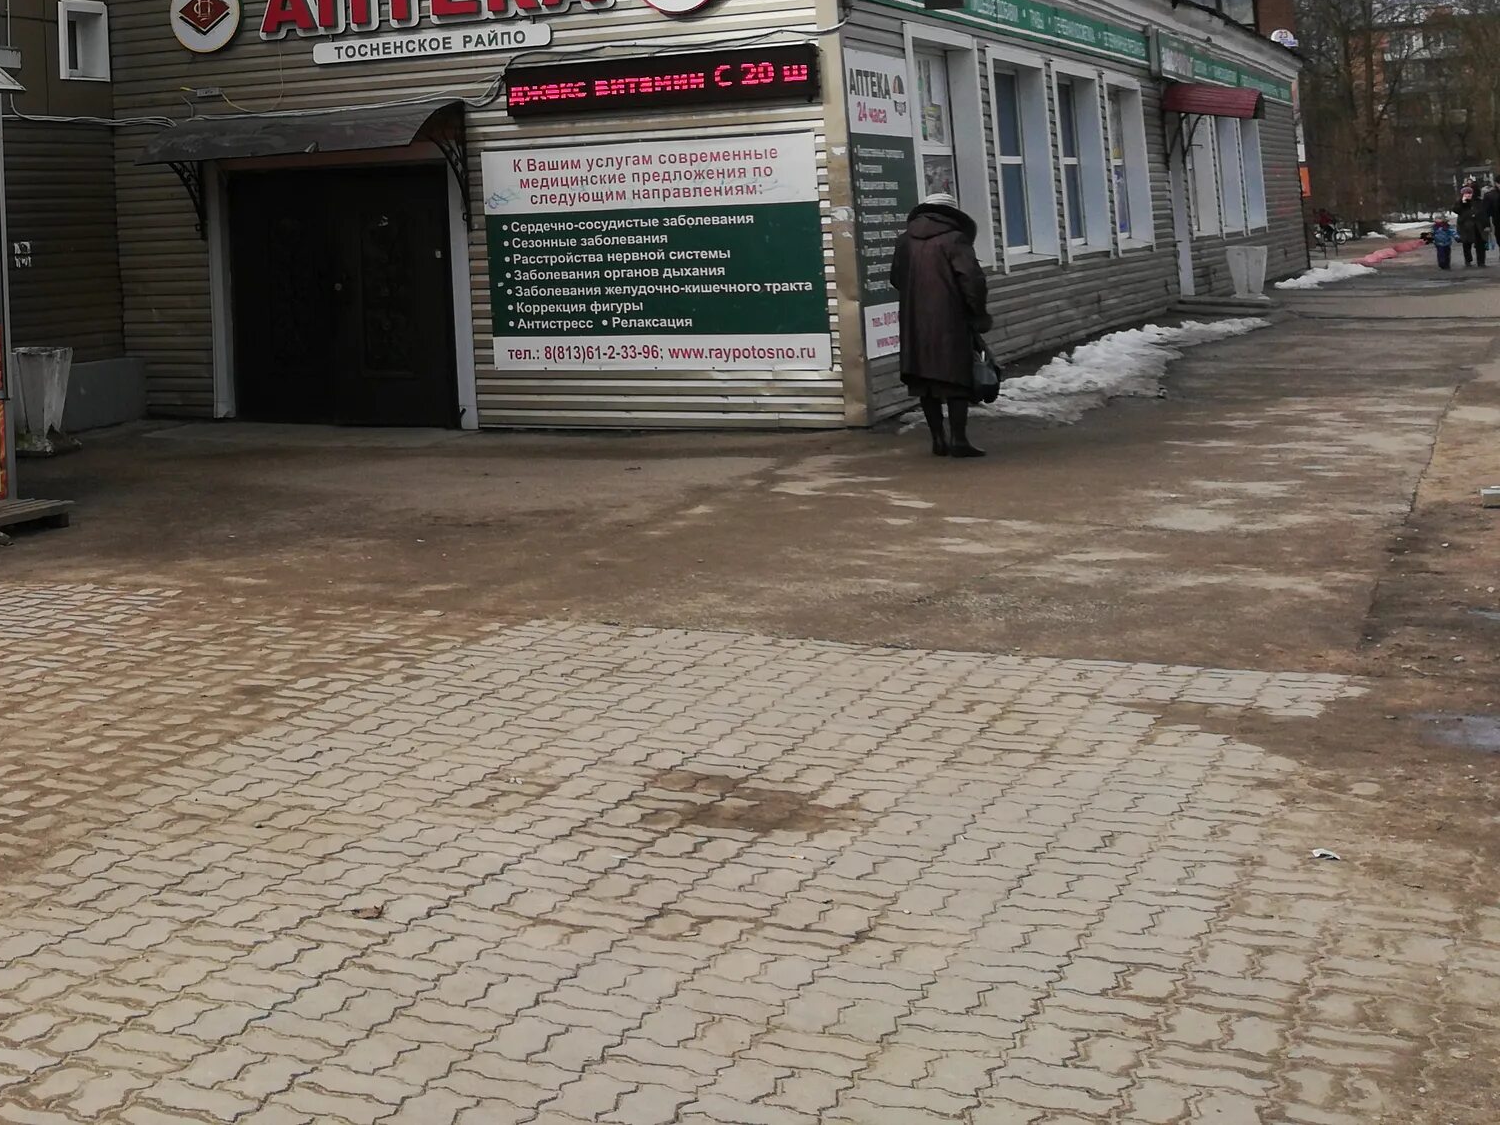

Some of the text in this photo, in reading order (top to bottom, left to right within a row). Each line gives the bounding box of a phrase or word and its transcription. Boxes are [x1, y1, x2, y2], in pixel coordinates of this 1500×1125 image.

[334, 28, 527, 61] ТОСНЕНСКОЕ РАЙПО
[740, 62, 775, 85] 20
[849, 68, 892, 100] АПТЕКА
[857, 101, 867, 122] 24
[513, 146, 779, 173] К Вашим услугам современные
[519, 165, 773, 190] медицинские предложения по
[530, 183, 764, 207] следующим направлениям:
[510, 213, 755, 234] Сердечно-сосудистые заболевания
[512, 233, 669, 249] Сезонные заболевания
[513, 249, 731, 266] Расстройства нервной системы
[514, 265, 726, 281] Заболевания органов дыхания
[515, 280, 813, 298] Заболевания желудочно-кишечного тракта
[516, 300, 644, 316] Коррекция фигуры
[518, 316, 693, 330] Антистресс Релаксация
[507, 344, 816, 363] тел.: 8(813)61-2-33-96; www.raypotosno.ru
